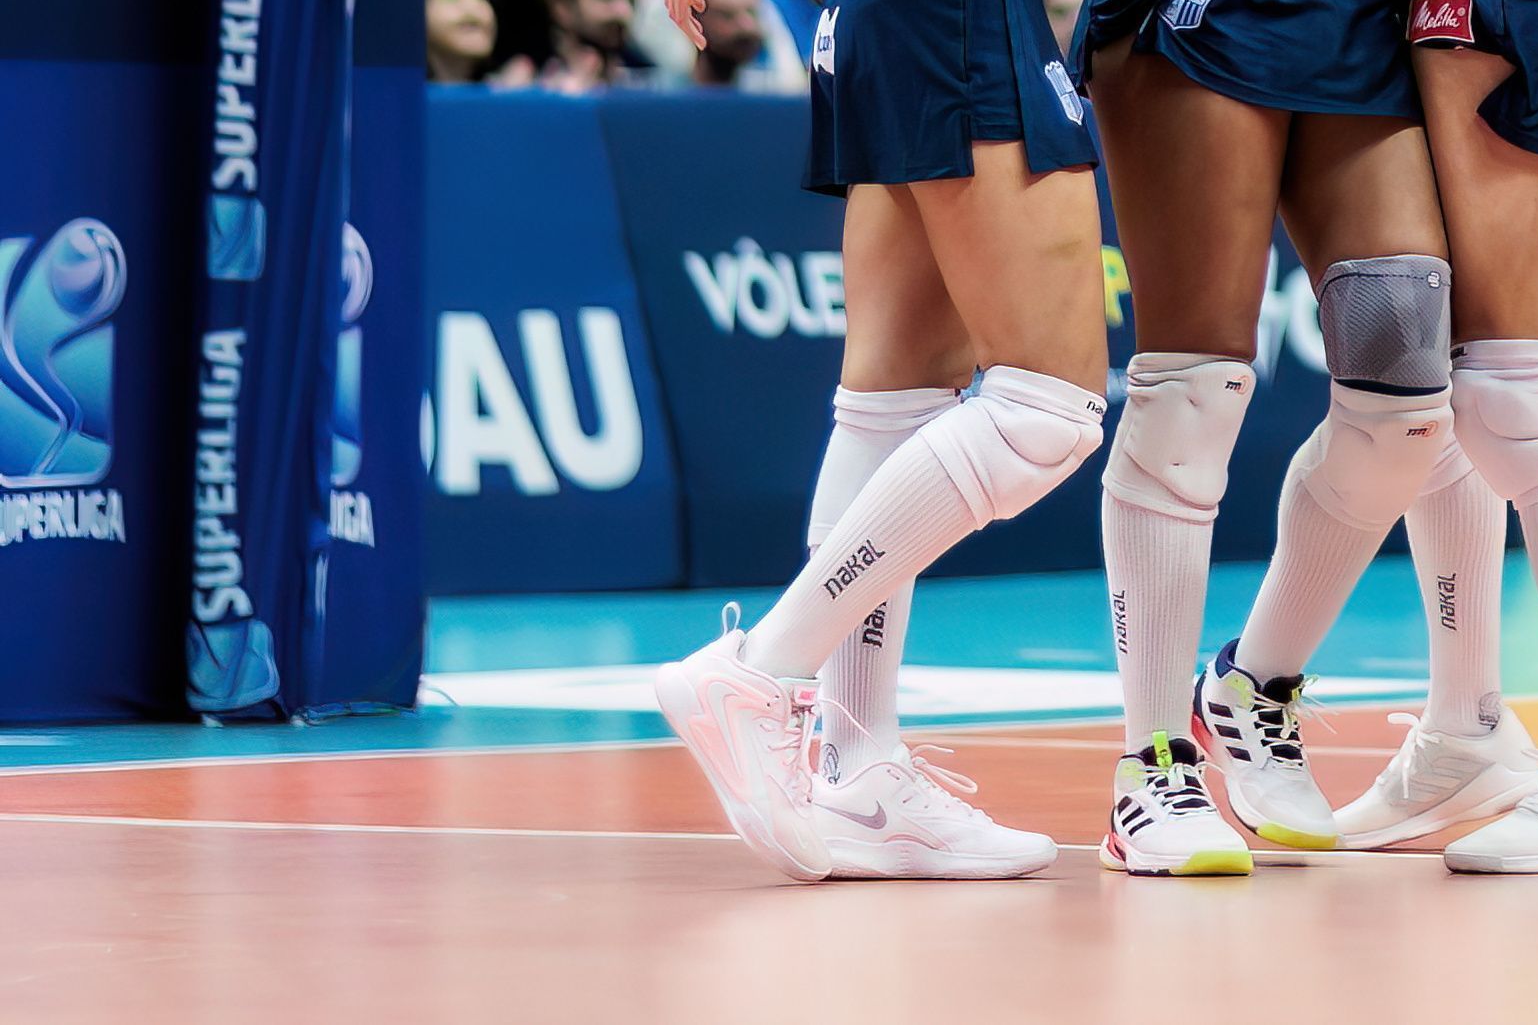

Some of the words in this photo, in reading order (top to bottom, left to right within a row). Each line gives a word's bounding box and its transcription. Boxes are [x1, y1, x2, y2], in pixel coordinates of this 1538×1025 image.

[1414, 0, 1461, 30] Melitta
[420, 306, 644, 496] AU
[190, 327, 247, 623] SUPERLIGA
[823, 538, 887, 600] nakal
[1116, 589, 1128, 654] nakal
[1440, 572, 1457, 631] nakal
